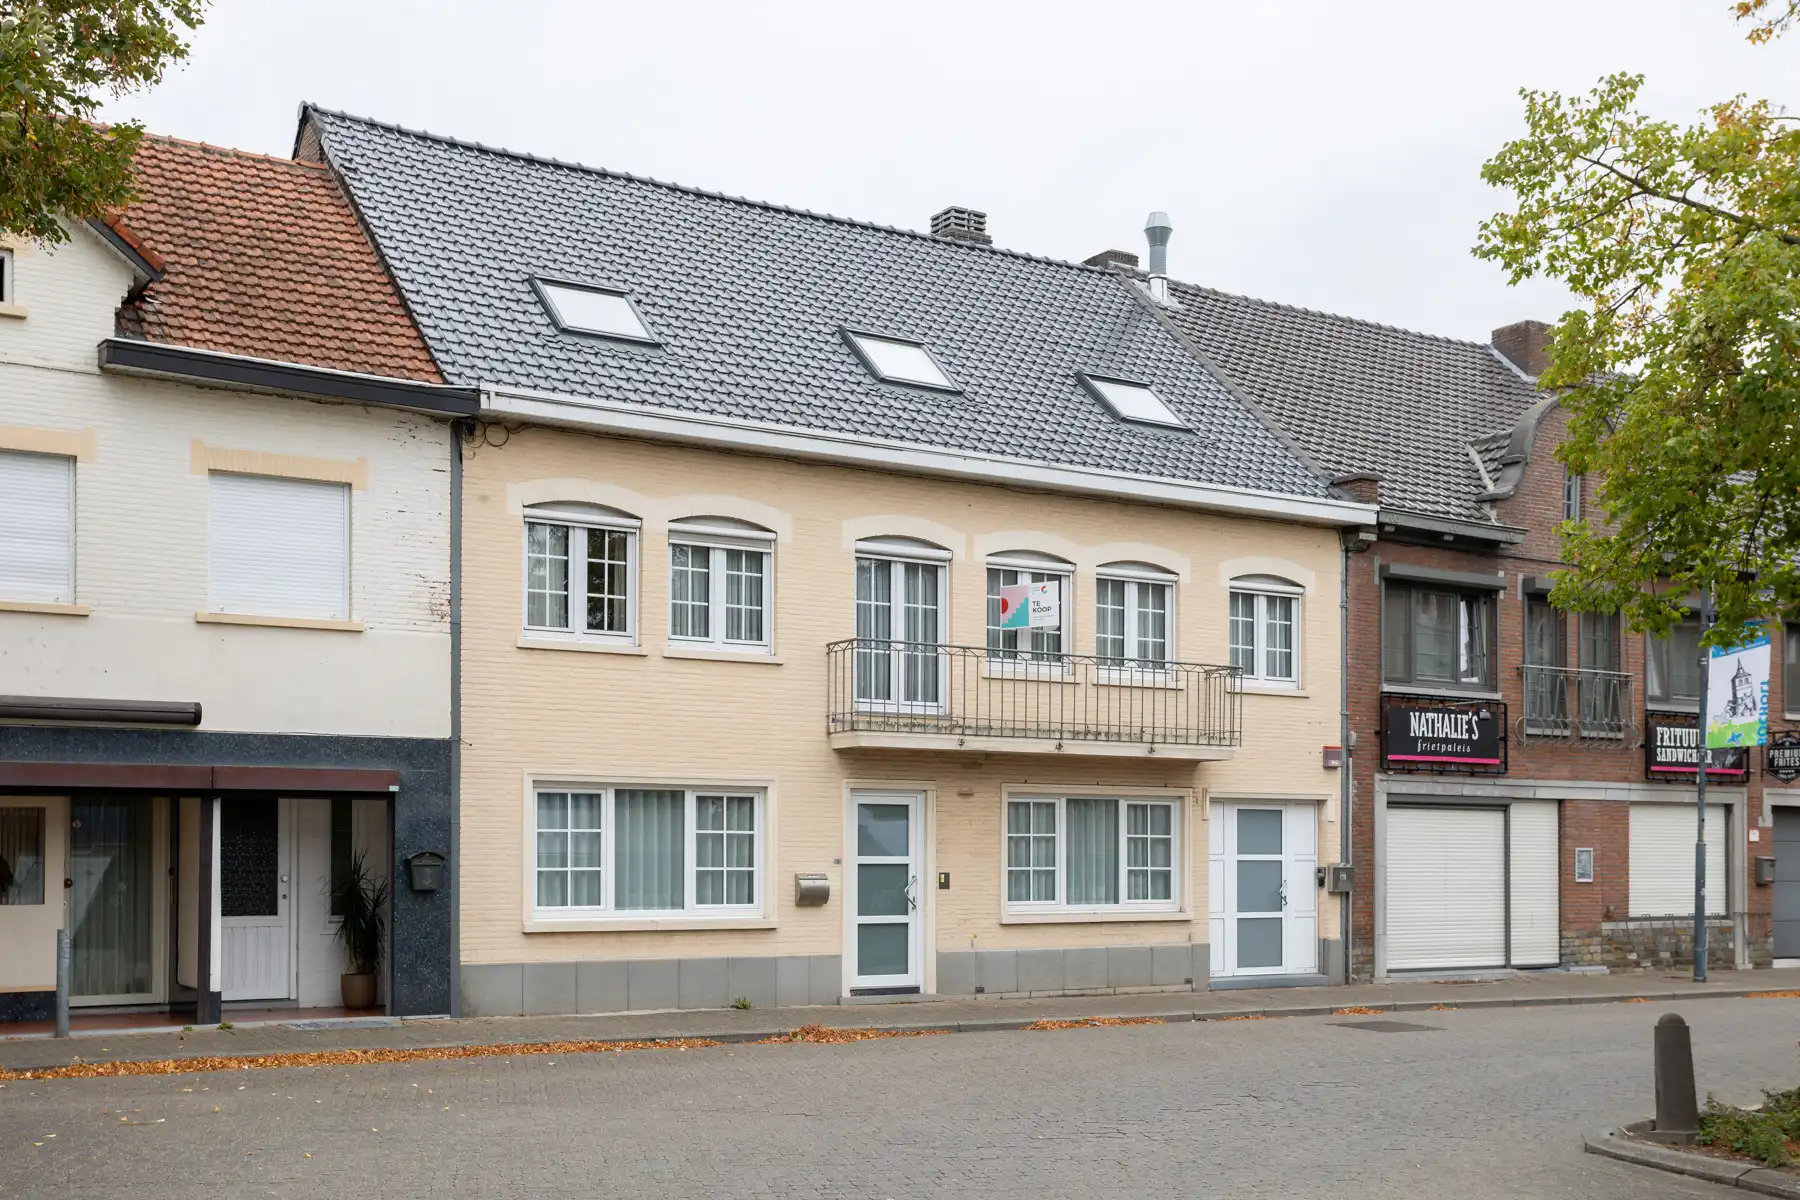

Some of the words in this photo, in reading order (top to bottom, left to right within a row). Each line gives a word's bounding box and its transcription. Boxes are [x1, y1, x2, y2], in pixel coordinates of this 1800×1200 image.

[1409, 711, 1479, 740] NATHALIE'S
[1656, 727, 1700, 747] FRITUU
[1417, 739, 1471, 753] frietpaleis
[1769, 749, 1800, 758] PREMIU
[1774, 758, 1800, 767] FRITES
